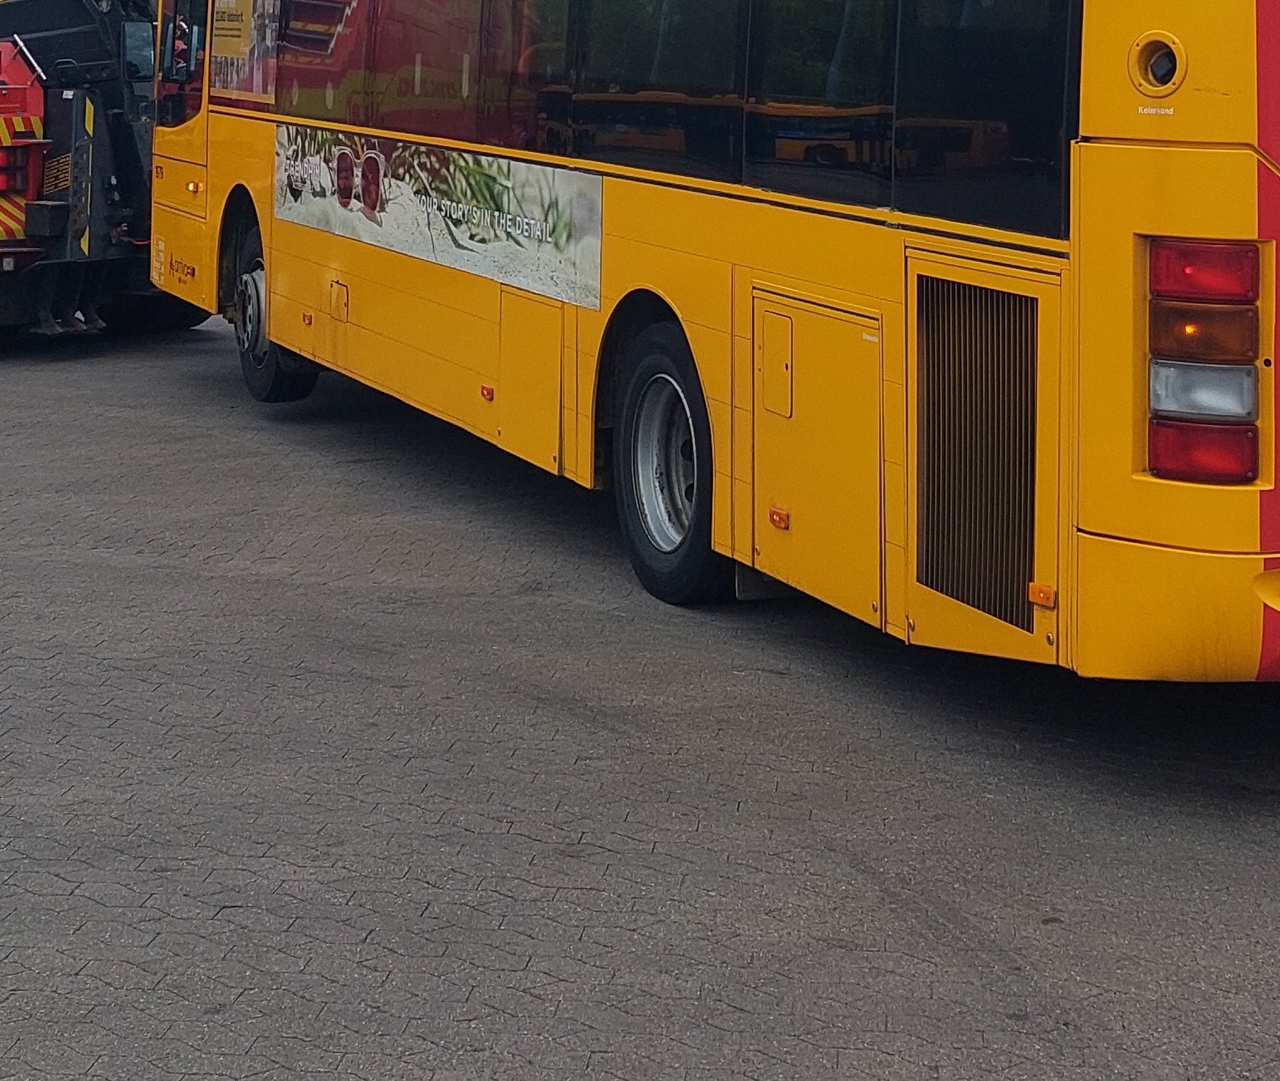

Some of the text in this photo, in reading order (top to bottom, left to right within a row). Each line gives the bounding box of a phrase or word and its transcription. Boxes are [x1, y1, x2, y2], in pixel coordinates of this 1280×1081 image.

[416, 194, 439, 213] YOUR
[479, 209, 491, 227] IN
[494, 211, 512, 232] THE
[515, 217, 552, 243] DETAIL
